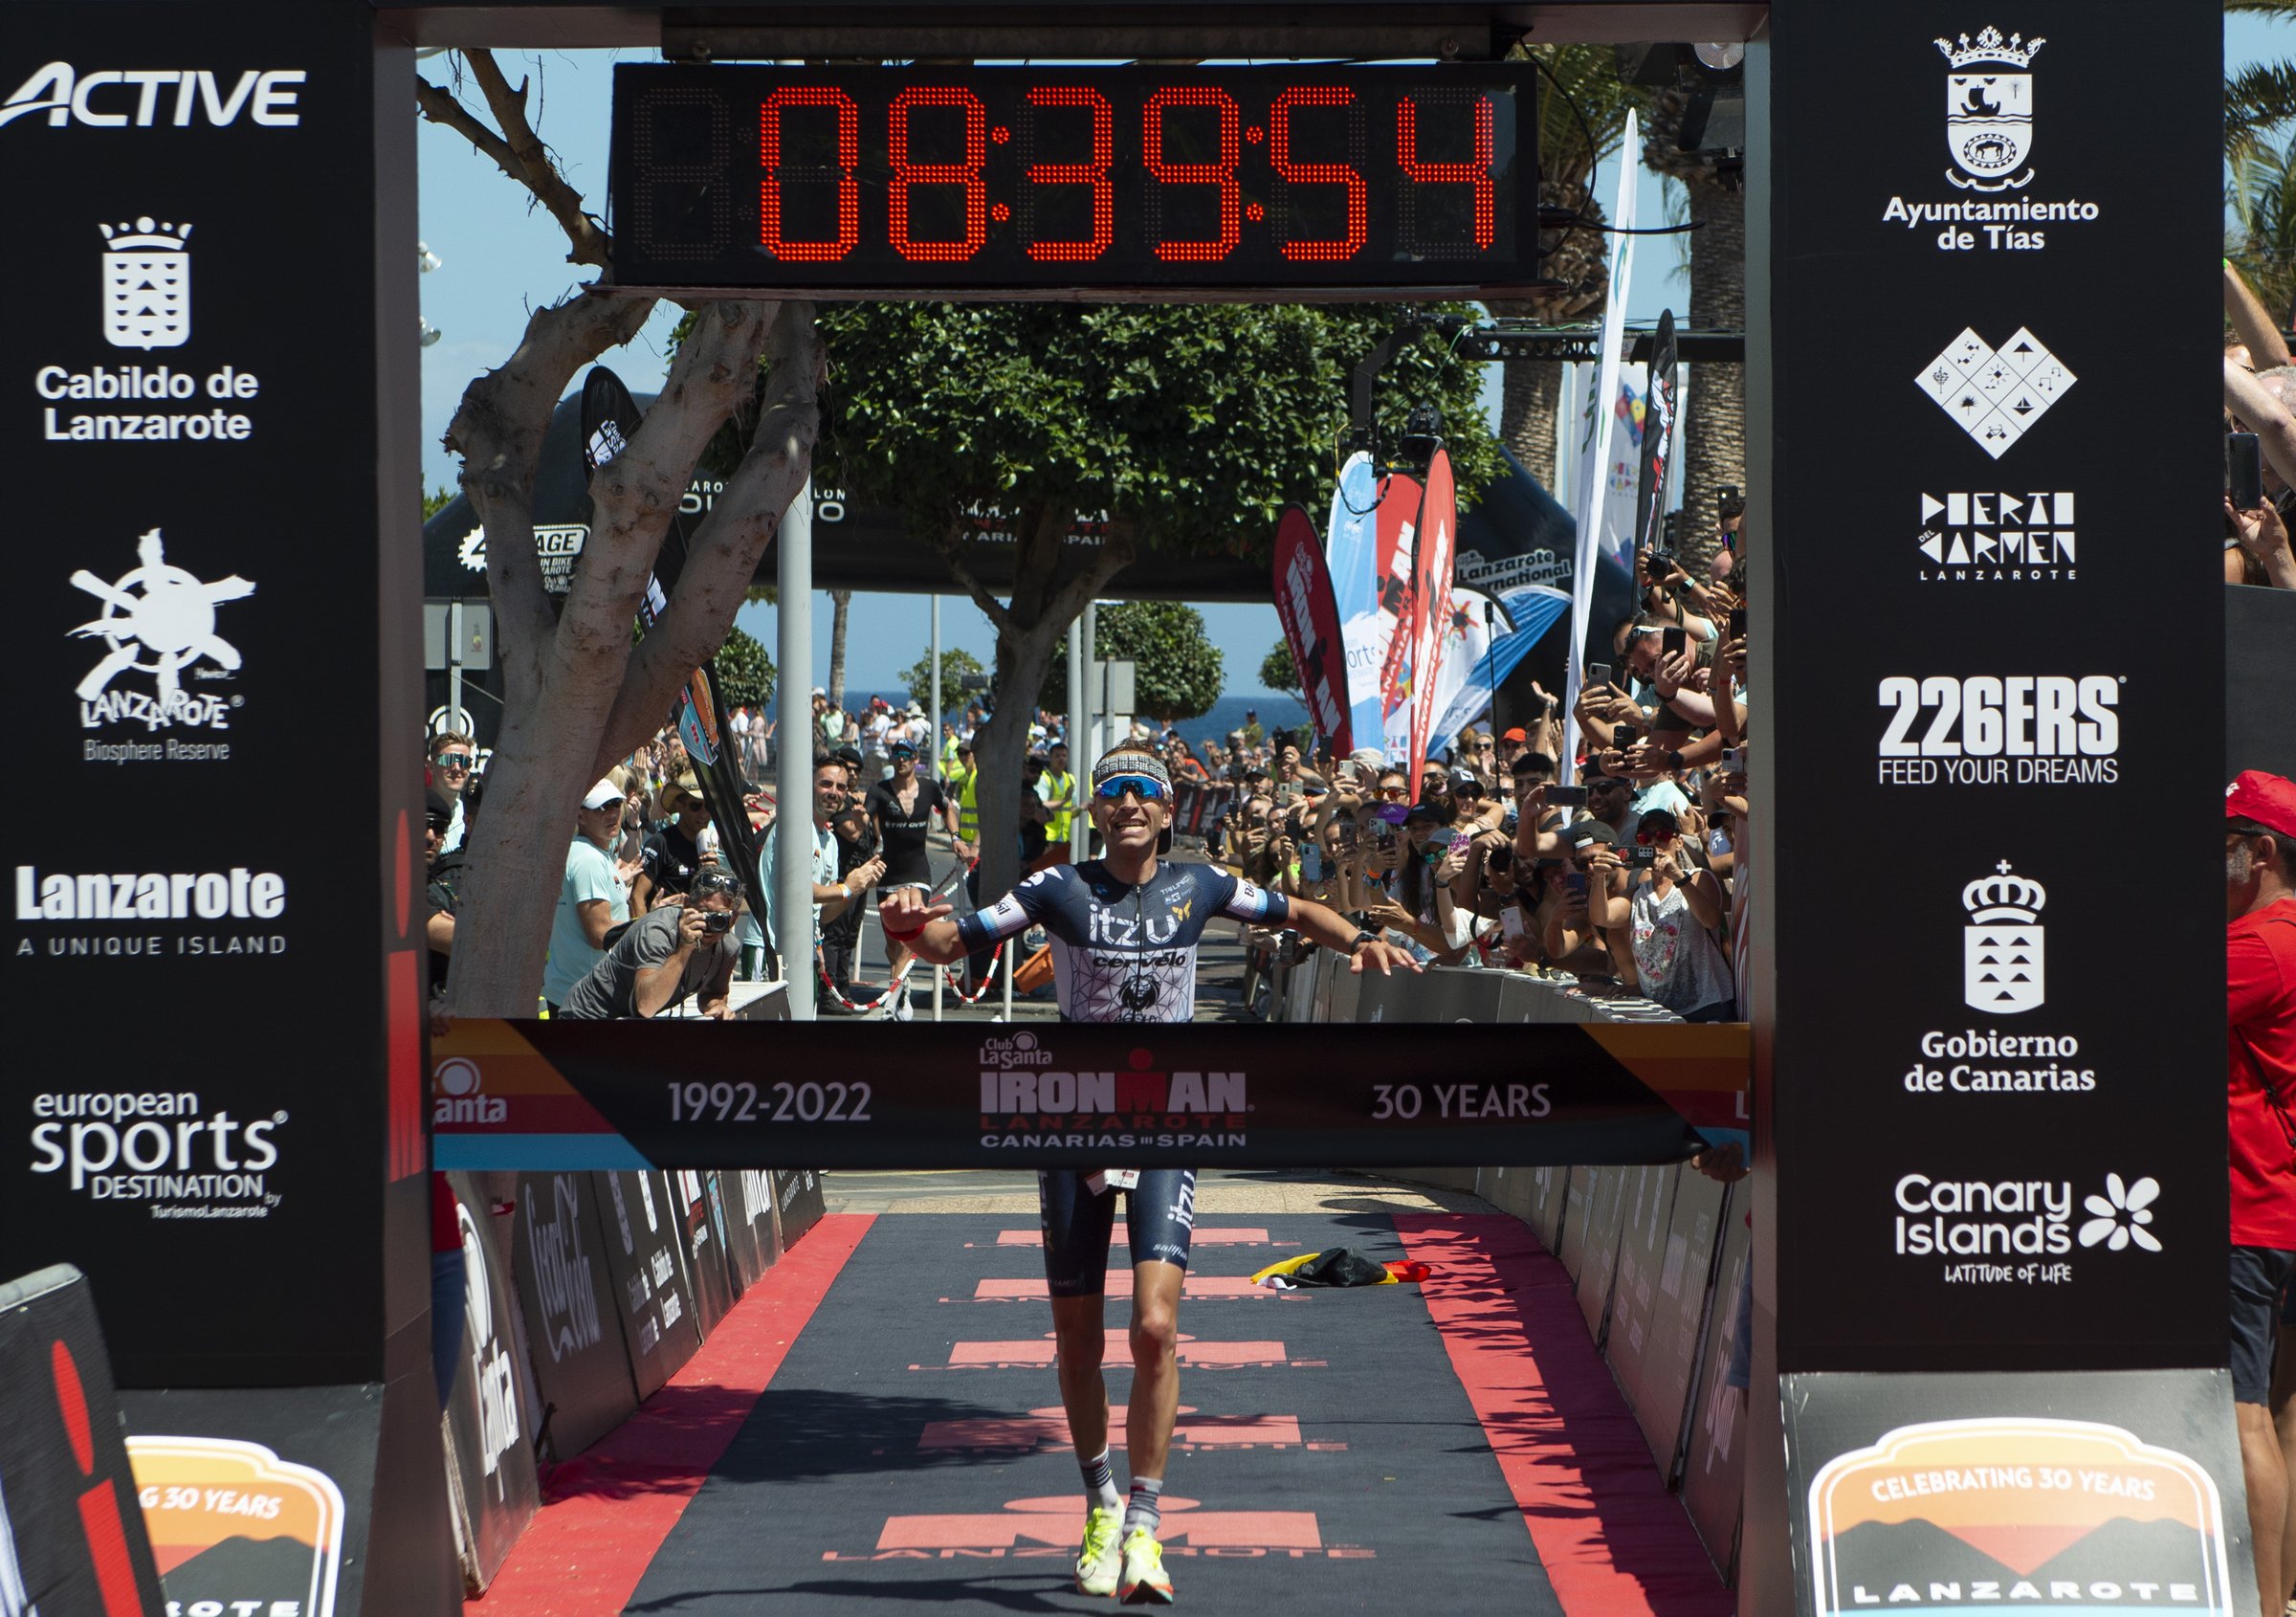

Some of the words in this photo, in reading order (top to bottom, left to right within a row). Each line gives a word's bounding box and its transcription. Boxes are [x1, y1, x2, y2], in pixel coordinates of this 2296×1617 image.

[0, 61, 306, 126] ACTIVE
[760, 85, 1495, 263] 08:39:54
[1883, 196, 2099, 230] Ayuntamiento
[1938, 226, 1974, 250] de
[1983, 225, 2044, 249] Tías
[36, 365, 194, 399] Cabildo
[207, 365, 258, 398] de
[45, 408, 251, 440] Lanzarote
[1922, 493, 2074, 525] PUERTO
[1918, 529, 1934, 543] DEL
[1918, 530, 2075, 564] CARMEN
[1459, 552, 1553, 581] Lanzarote
[1480, 562, 1570, 590] rnational
[1921, 570, 2075, 580] LANZAROTE
[80, 688, 230, 732] LANZAROTE
[1879, 676, 2118, 756] 226ERS
[84, 740, 163, 764] Biosphere
[166, 739, 229, 760] Reserve
[1880, 760, 1937, 784] FEED
[1944, 759, 2008, 784] YOUR
[2018, 759, 2118, 783] DREAMS
[16, 866, 284, 919] Lanzarote
[17, 939, 33, 955] A
[50, 937, 161, 955] UNIQUE
[178, 936, 285, 954] ISLAND
[979, 1048, 1052, 1070] LaSanta
[985, 1037, 1013, 1051] Club
[1922, 1030, 2078, 1057] Gobierno
[981, 1072, 1247, 1113] IRONMAN
[1905, 1064, 1943, 1092] de
[1950, 1063, 2095, 1091] Canarias
[33, 1093, 201, 1124] european
[669, 1082, 871, 1120] 1992-2022
[1372, 1083, 1422, 1119] 30
[1432, 1082, 1552, 1119] YEARS
[980, 1116, 1246, 1129] LANZAROTE
[30, 1111, 277, 1190] sports
[980, 1135, 1136, 1147] CANARIAS
[1157, 1135, 1247, 1146] SPAIN
[93, 1175, 262, 1199] DESTINATION
[264, 1191, 282, 1207] by
[1895, 1174, 2071, 1225] Canary
[1895, 1216, 2071, 1254] Islands
[1945, 1264, 2013, 1284] LATITUDE
[2018, 1263, 2039, 1284] OF
[2042, 1263, 2071, 1284] LIFE
[1871, 1468, 2032, 1501] CELEBRATING
[2039, 1468, 2072, 1489] 30
[2079, 1471, 2155, 1501] YEARS
[163, 1488, 199, 1509] 30
[206, 1490, 281, 1518] YEARS
[1853, 1581, 2199, 1605] LANZAROTE
